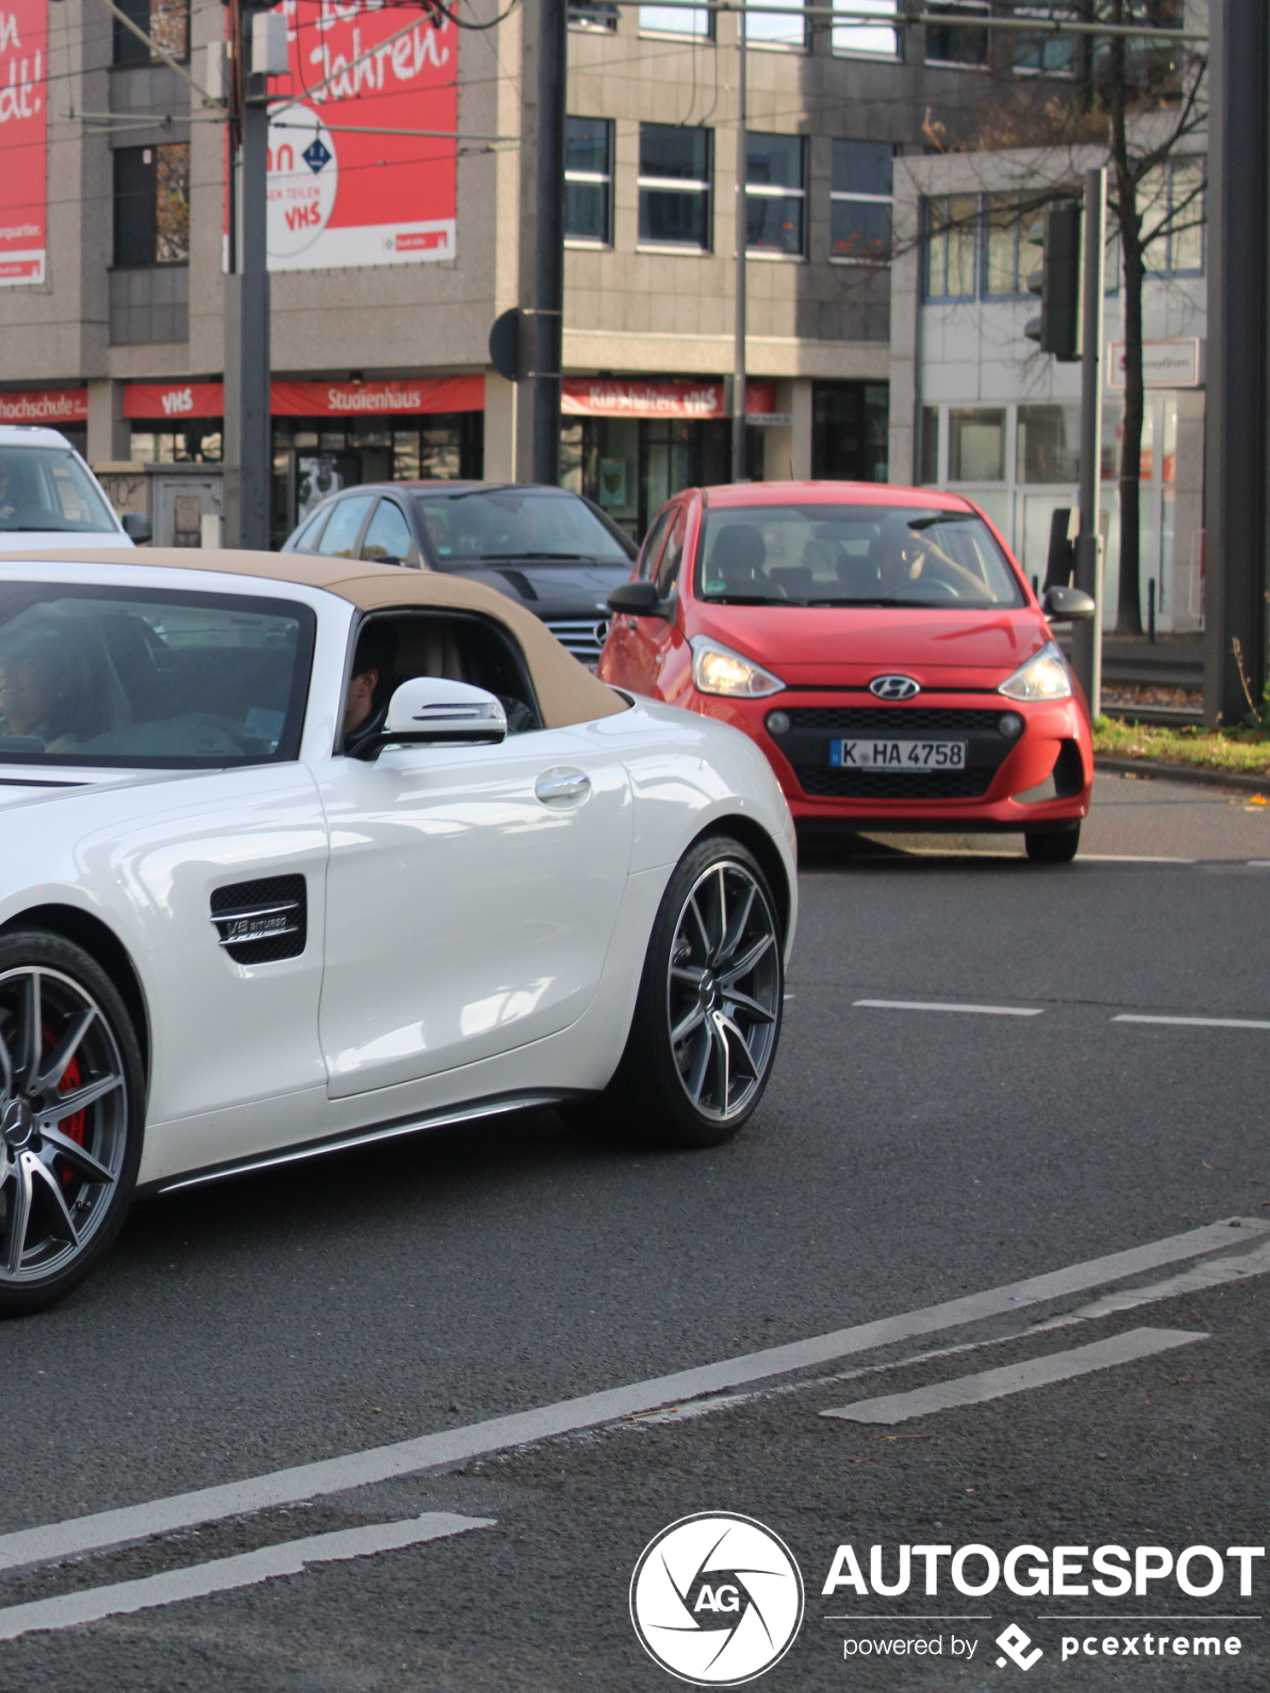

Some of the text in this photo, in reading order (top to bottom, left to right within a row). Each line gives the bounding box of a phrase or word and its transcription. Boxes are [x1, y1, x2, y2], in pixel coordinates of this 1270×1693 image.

[287, 187, 321, 198] TEILEN
[285, 201, 322, 231] VHS
[162, 388, 194, 414] VHS
[327, 388, 421, 411] Studienhaus
[682, 386, 718, 415] VHS
[843, 743, 857, 764] K
[873, 743, 901, 764] HA
[907, 744, 962, 765] 4758
[226, 917, 287, 935] V8 BITURBO
